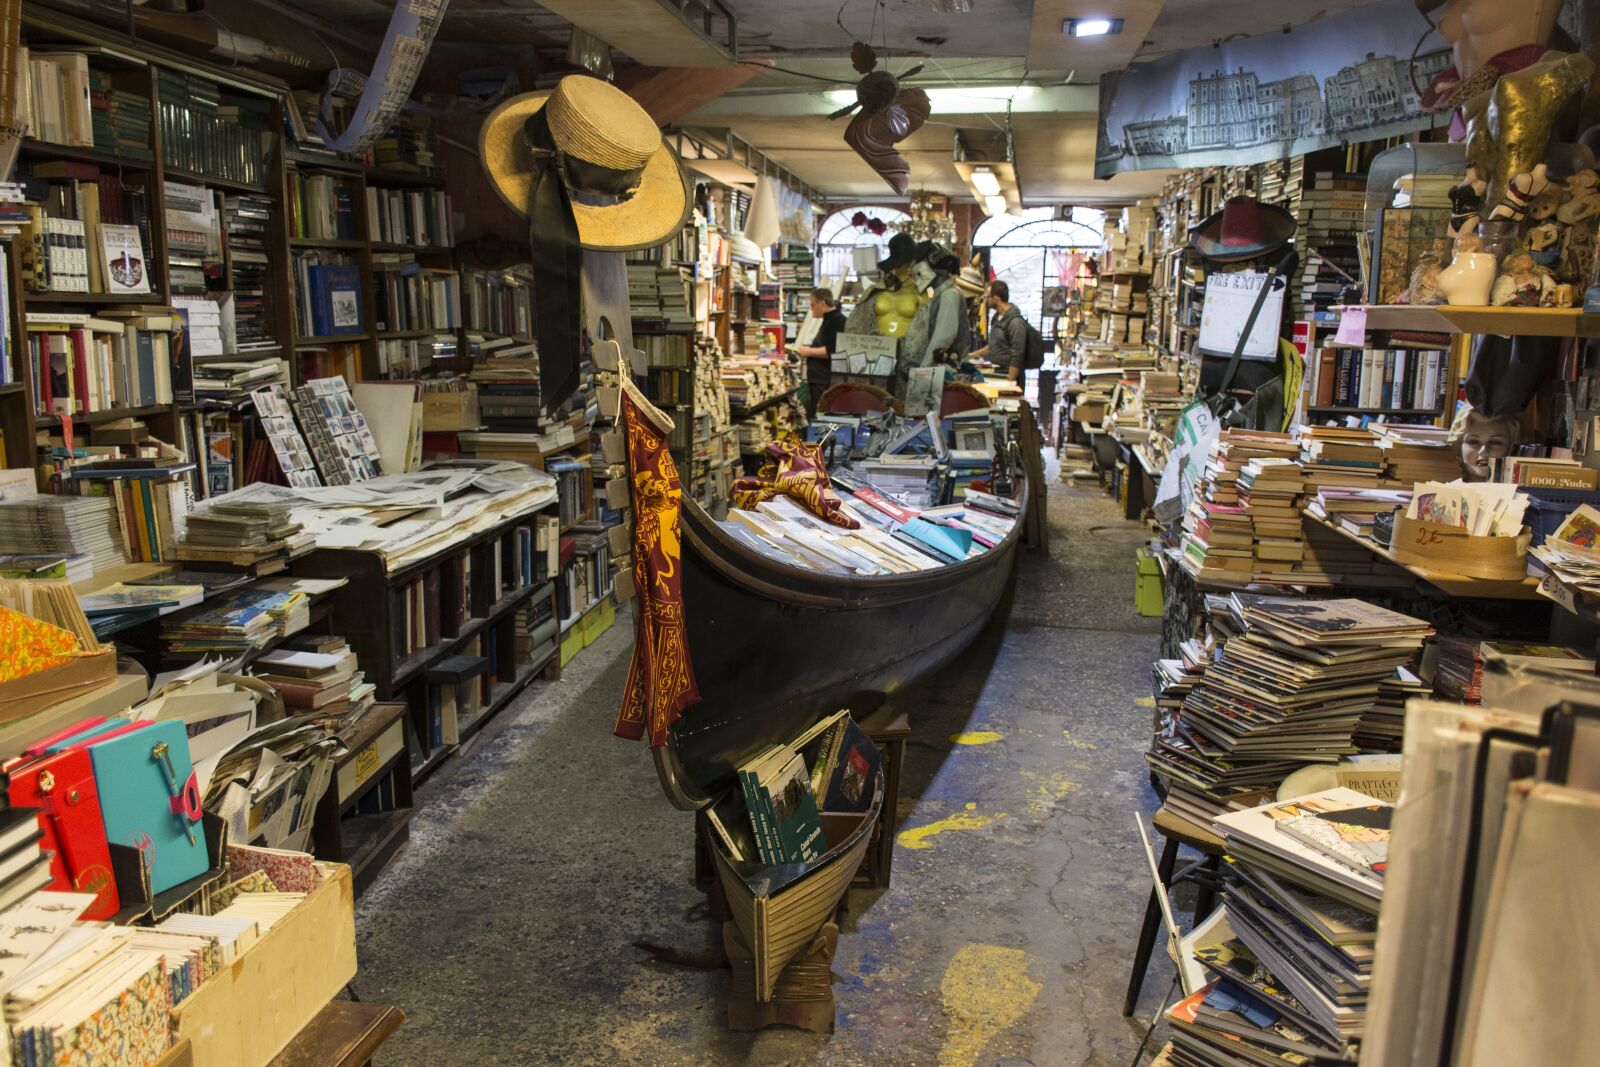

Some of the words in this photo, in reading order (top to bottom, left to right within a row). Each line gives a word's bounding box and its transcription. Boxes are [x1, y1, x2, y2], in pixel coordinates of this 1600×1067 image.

[1232, 275, 1265, 290] EXIT
[1440, 367, 1448, 394] LUDLUM
[1531, 476, 1556, 487] 1000
[1555, 478, 1593, 489] Nudes
